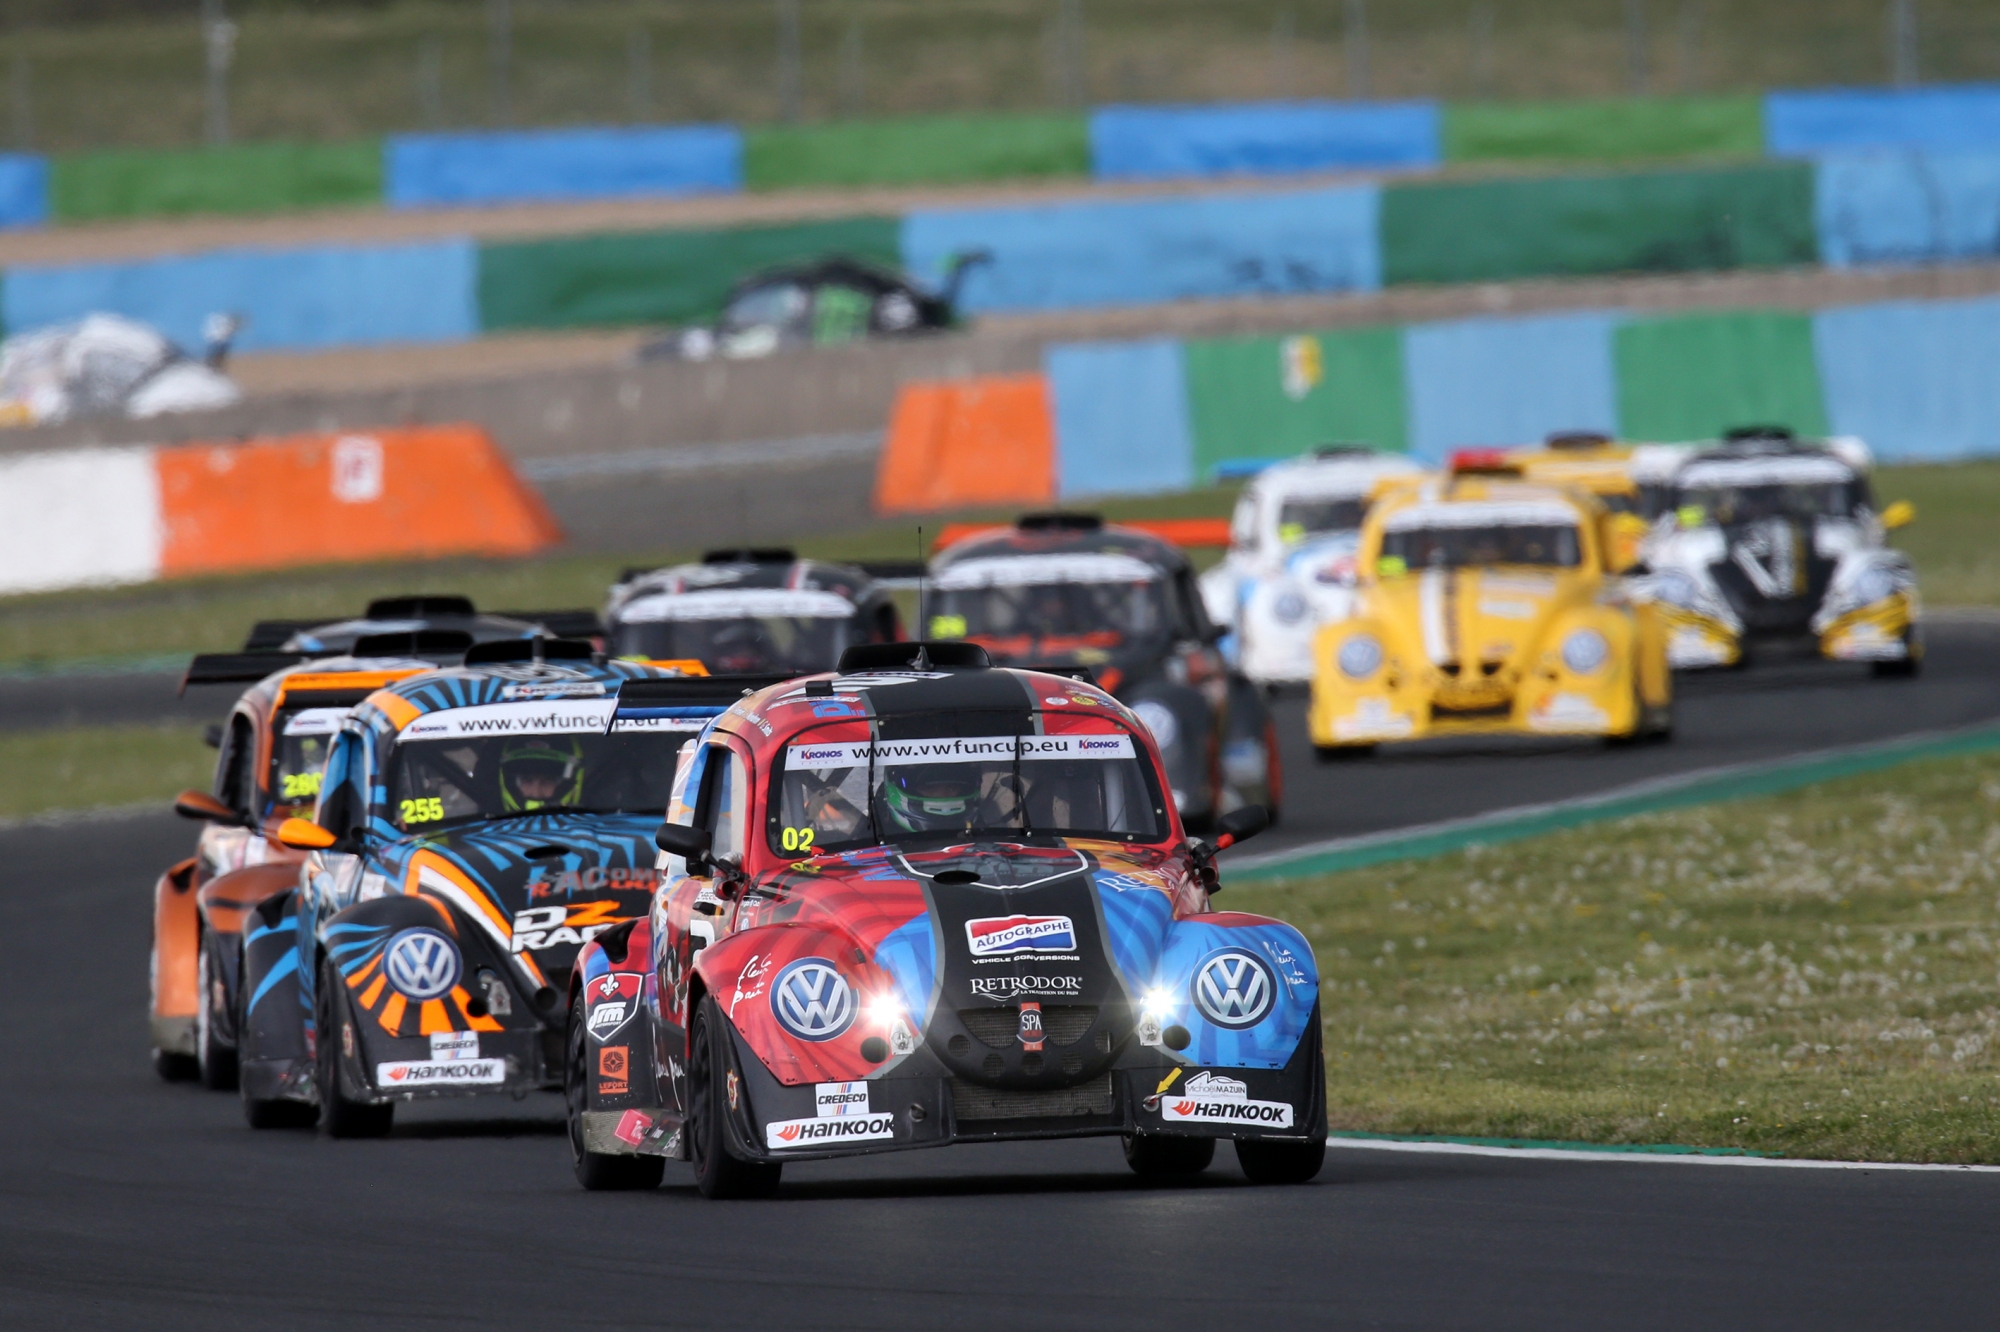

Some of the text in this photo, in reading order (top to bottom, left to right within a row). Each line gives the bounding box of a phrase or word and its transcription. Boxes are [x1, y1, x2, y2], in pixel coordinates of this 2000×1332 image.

[852, 741, 1068, 759] www.vwfuncup.eu
[1079, 737, 1120, 750] KRONOS
[801, 748, 843, 760] KRONOS
[400, 797, 444, 824] 255
[782, 827, 815, 851] 02
[976, 921, 1070, 949] AUTOGRAPHE
[1021, 1014, 1042, 1031] SPA
[818, 1093, 867, 1105] CREDECO
